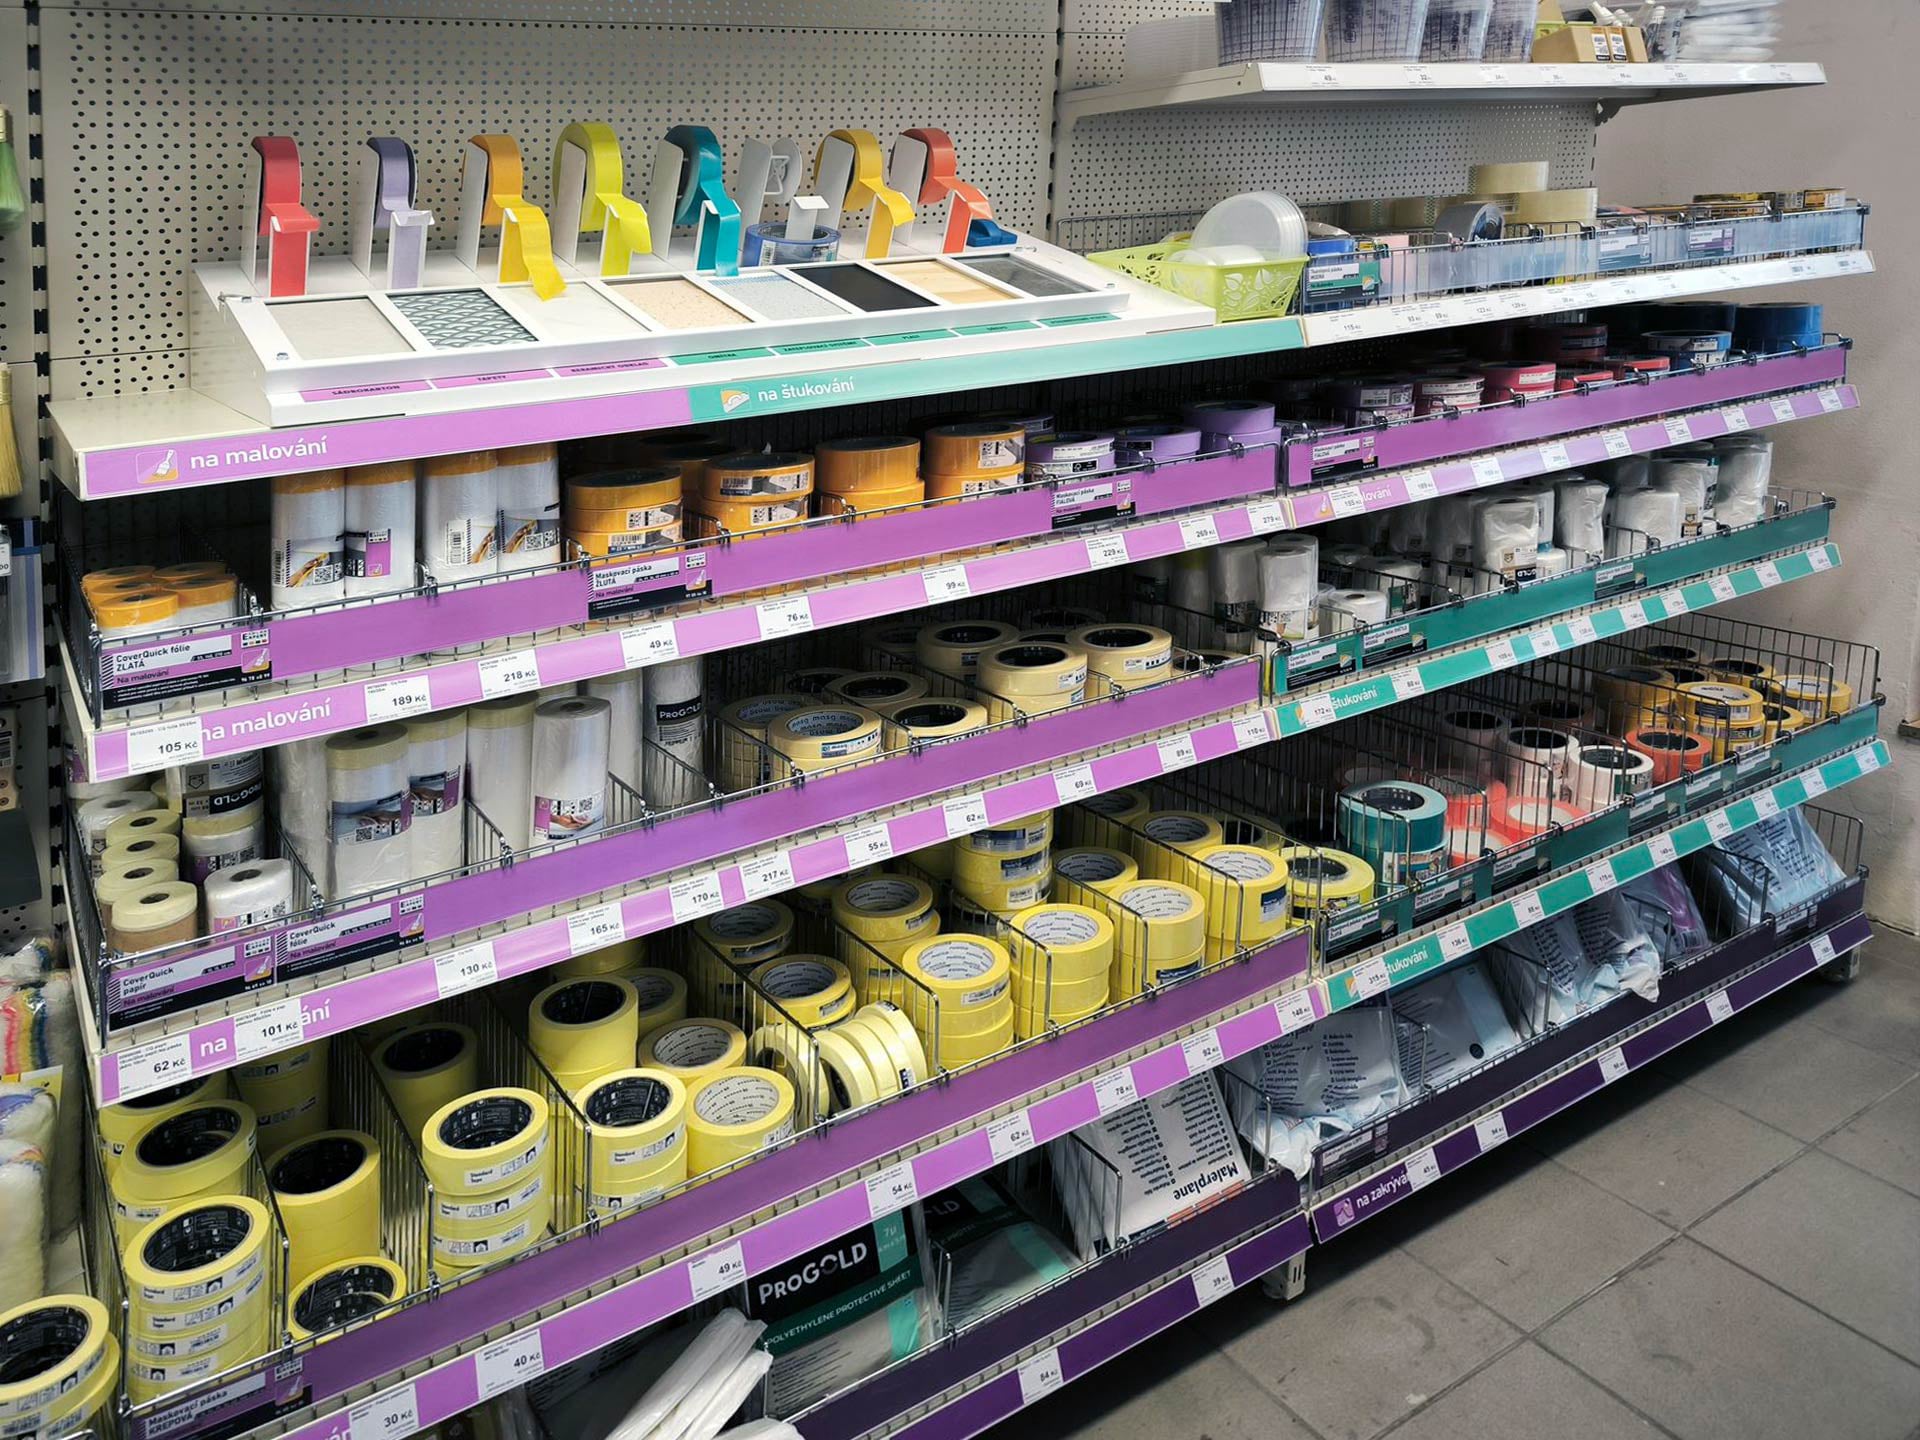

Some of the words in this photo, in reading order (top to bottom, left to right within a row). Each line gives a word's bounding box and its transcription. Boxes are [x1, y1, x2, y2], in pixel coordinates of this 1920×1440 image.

[332, 385, 400, 395] SÁDROKARTON
[758, 389, 778, 402] na
[782, 377, 855, 399] štukování
[191, 455, 218, 469] na
[226, 436, 328, 465] malování
[1362, 484, 1392, 502] lování
[595, 567, 631, 579] Maskovací
[632, 564, 652, 574] páska
[596, 578, 616, 588] ŽLUTÁ
[787, 612, 798, 622] 76
[799, 611, 809, 619] Kč
[649, 639, 661, 650] 49
[663, 638, 673, 647] Kč
[116, 648, 168, 664] CoverQuick
[171, 644, 191, 654] fólie
[117, 660, 145, 672] ZLATÁ
[117, 675, 128, 683] Na
[131, 669, 169, 682] malování
[504, 671, 523, 682] 218
[525, 669, 537, 678] Kč
[392, 695, 412, 707] 189
[414, 694, 427, 703] Kč
[232, 698, 332, 736] malování
[158, 742, 181, 754] 105
[185, 740, 198, 749] Kč
[966, 814, 976, 822] 62
[868, 841, 879, 852] 55
[762, 871, 778, 882] 217
[779, 869, 789, 878] Kč
[692, 892, 708, 904] 170
[710, 891, 720, 899] Kč
[289, 920, 336, 941] CoverQuick
[590, 923, 608, 935] 165
[610, 921, 620, 930] Kč
[289, 936, 308, 949] fólie
[1387, 944, 1428, 975] tukování
[123, 965, 175, 987] CoverQuick
[460, 963, 480, 977] 130
[481, 961, 493, 971] Kč
[123, 982, 147, 997] papír
[262, 1023, 282, 1037] 101
[286, 1021, 298, 1031] Kč
[200, 1037, 228, 1057] na
[154, 1060, 170, 1073] 62
[173, 1058, 186, 1068] Kč
[614, 1151, 635, 1159] Standard
[470, 1169, 493, 1179] Standard
[1173, 1162, 1239, 1200] Malerplane
[904, 1181, 913, 1190] Kč
[1356, 1196, 1369, 1209] na
[1370, 1170, 1408, 1204] zakrývá
[719, 1263, 731, 1275] 49
[732, 1260, 743, 1269] Kč
[758, 1242, 867, 1305] PROGOLD
[767, 1310, 835, 1347] POLYETHYLENE
[836, 1285, 887, 1315] PROTECTIVE
[887, 1269, 912, 1288] SHEET
[514, 1355, 528, 1368] 40
[530, 1351, 541, 1361] Kč
[148, 1399, 199, 1425] Maskovací
[200, 1389, 228, 1407] páska
[148, 1411, 194, 1435] KREPOVÁ
[384, 1413, 399, 1428] 30
[401, 1409, 413, 1420] Kč
